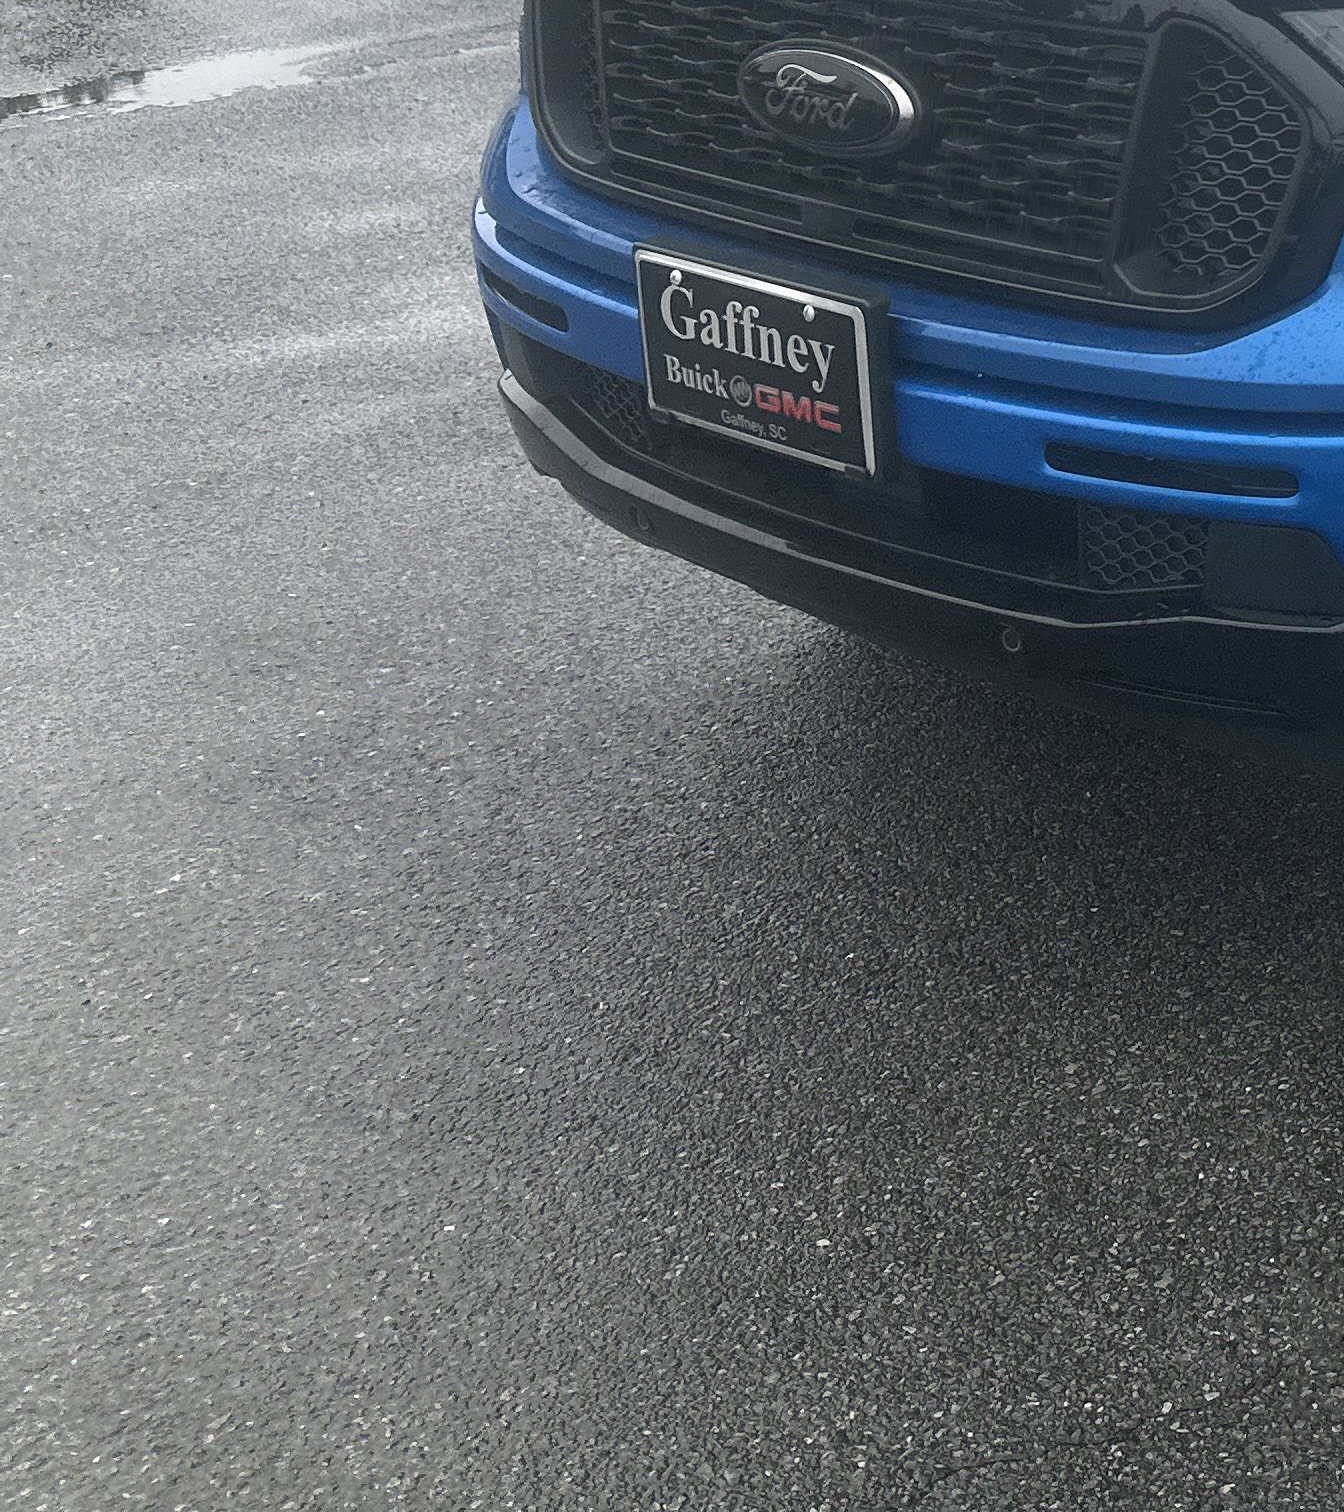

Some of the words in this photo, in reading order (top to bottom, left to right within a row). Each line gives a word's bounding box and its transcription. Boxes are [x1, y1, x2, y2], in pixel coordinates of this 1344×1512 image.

[765, 63, 858, 130] Ford
[660, 284, 836, 393] Gaffney
[663, 353, 730, 400] Buick
[755, 383, 842, 433] GMC
[720, 409, 767, 438] Gaffney,
[768, 423, 788, 441] SC
